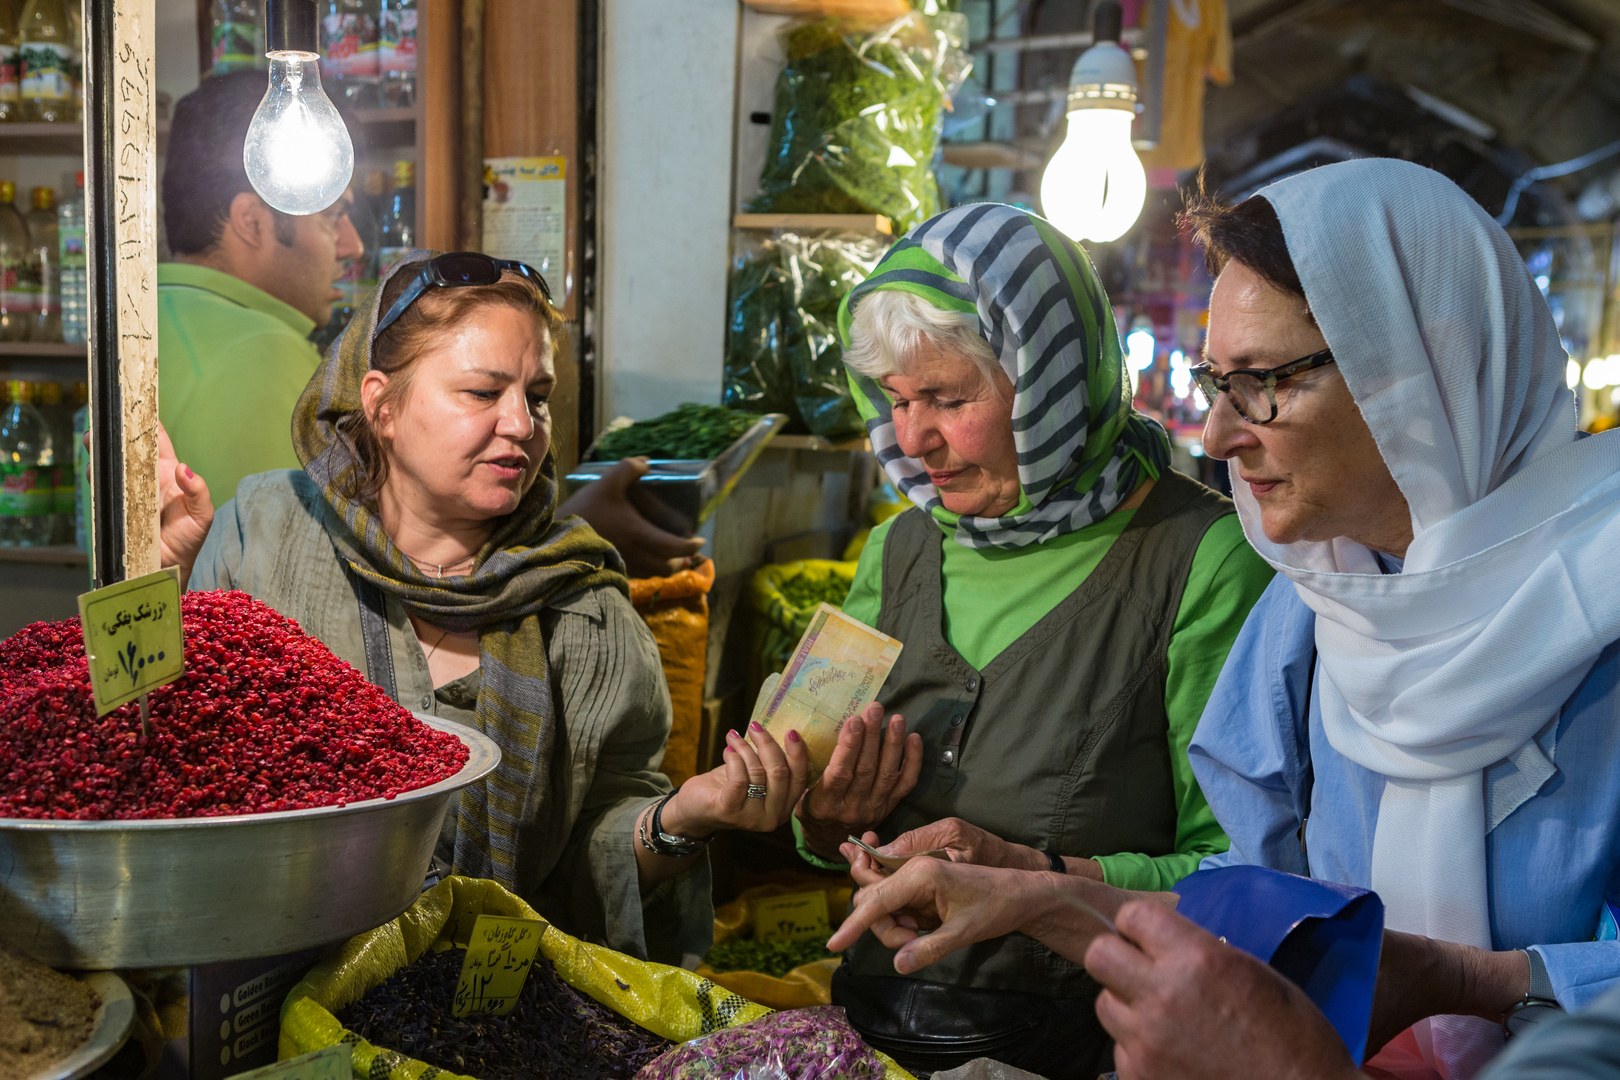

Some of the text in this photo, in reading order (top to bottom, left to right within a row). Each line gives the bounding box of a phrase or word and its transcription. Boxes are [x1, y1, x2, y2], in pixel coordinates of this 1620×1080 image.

[796, 638, 814, 663] RIALS
[783, 673, 794, 689] FIFTY
[858, 674, 875, 697] CENTRAL
[765, 687, 786, 718] THOUSAND
[833, 667, 873, 733] ISLAMIC REPUBLIC OF IRAN
[850, 697, 862, 713] BANK
[237, 983, 262, 1002] Golden
[238, 1010, 259, 1027] Green
[238, 1033, 259, 1053] Black
